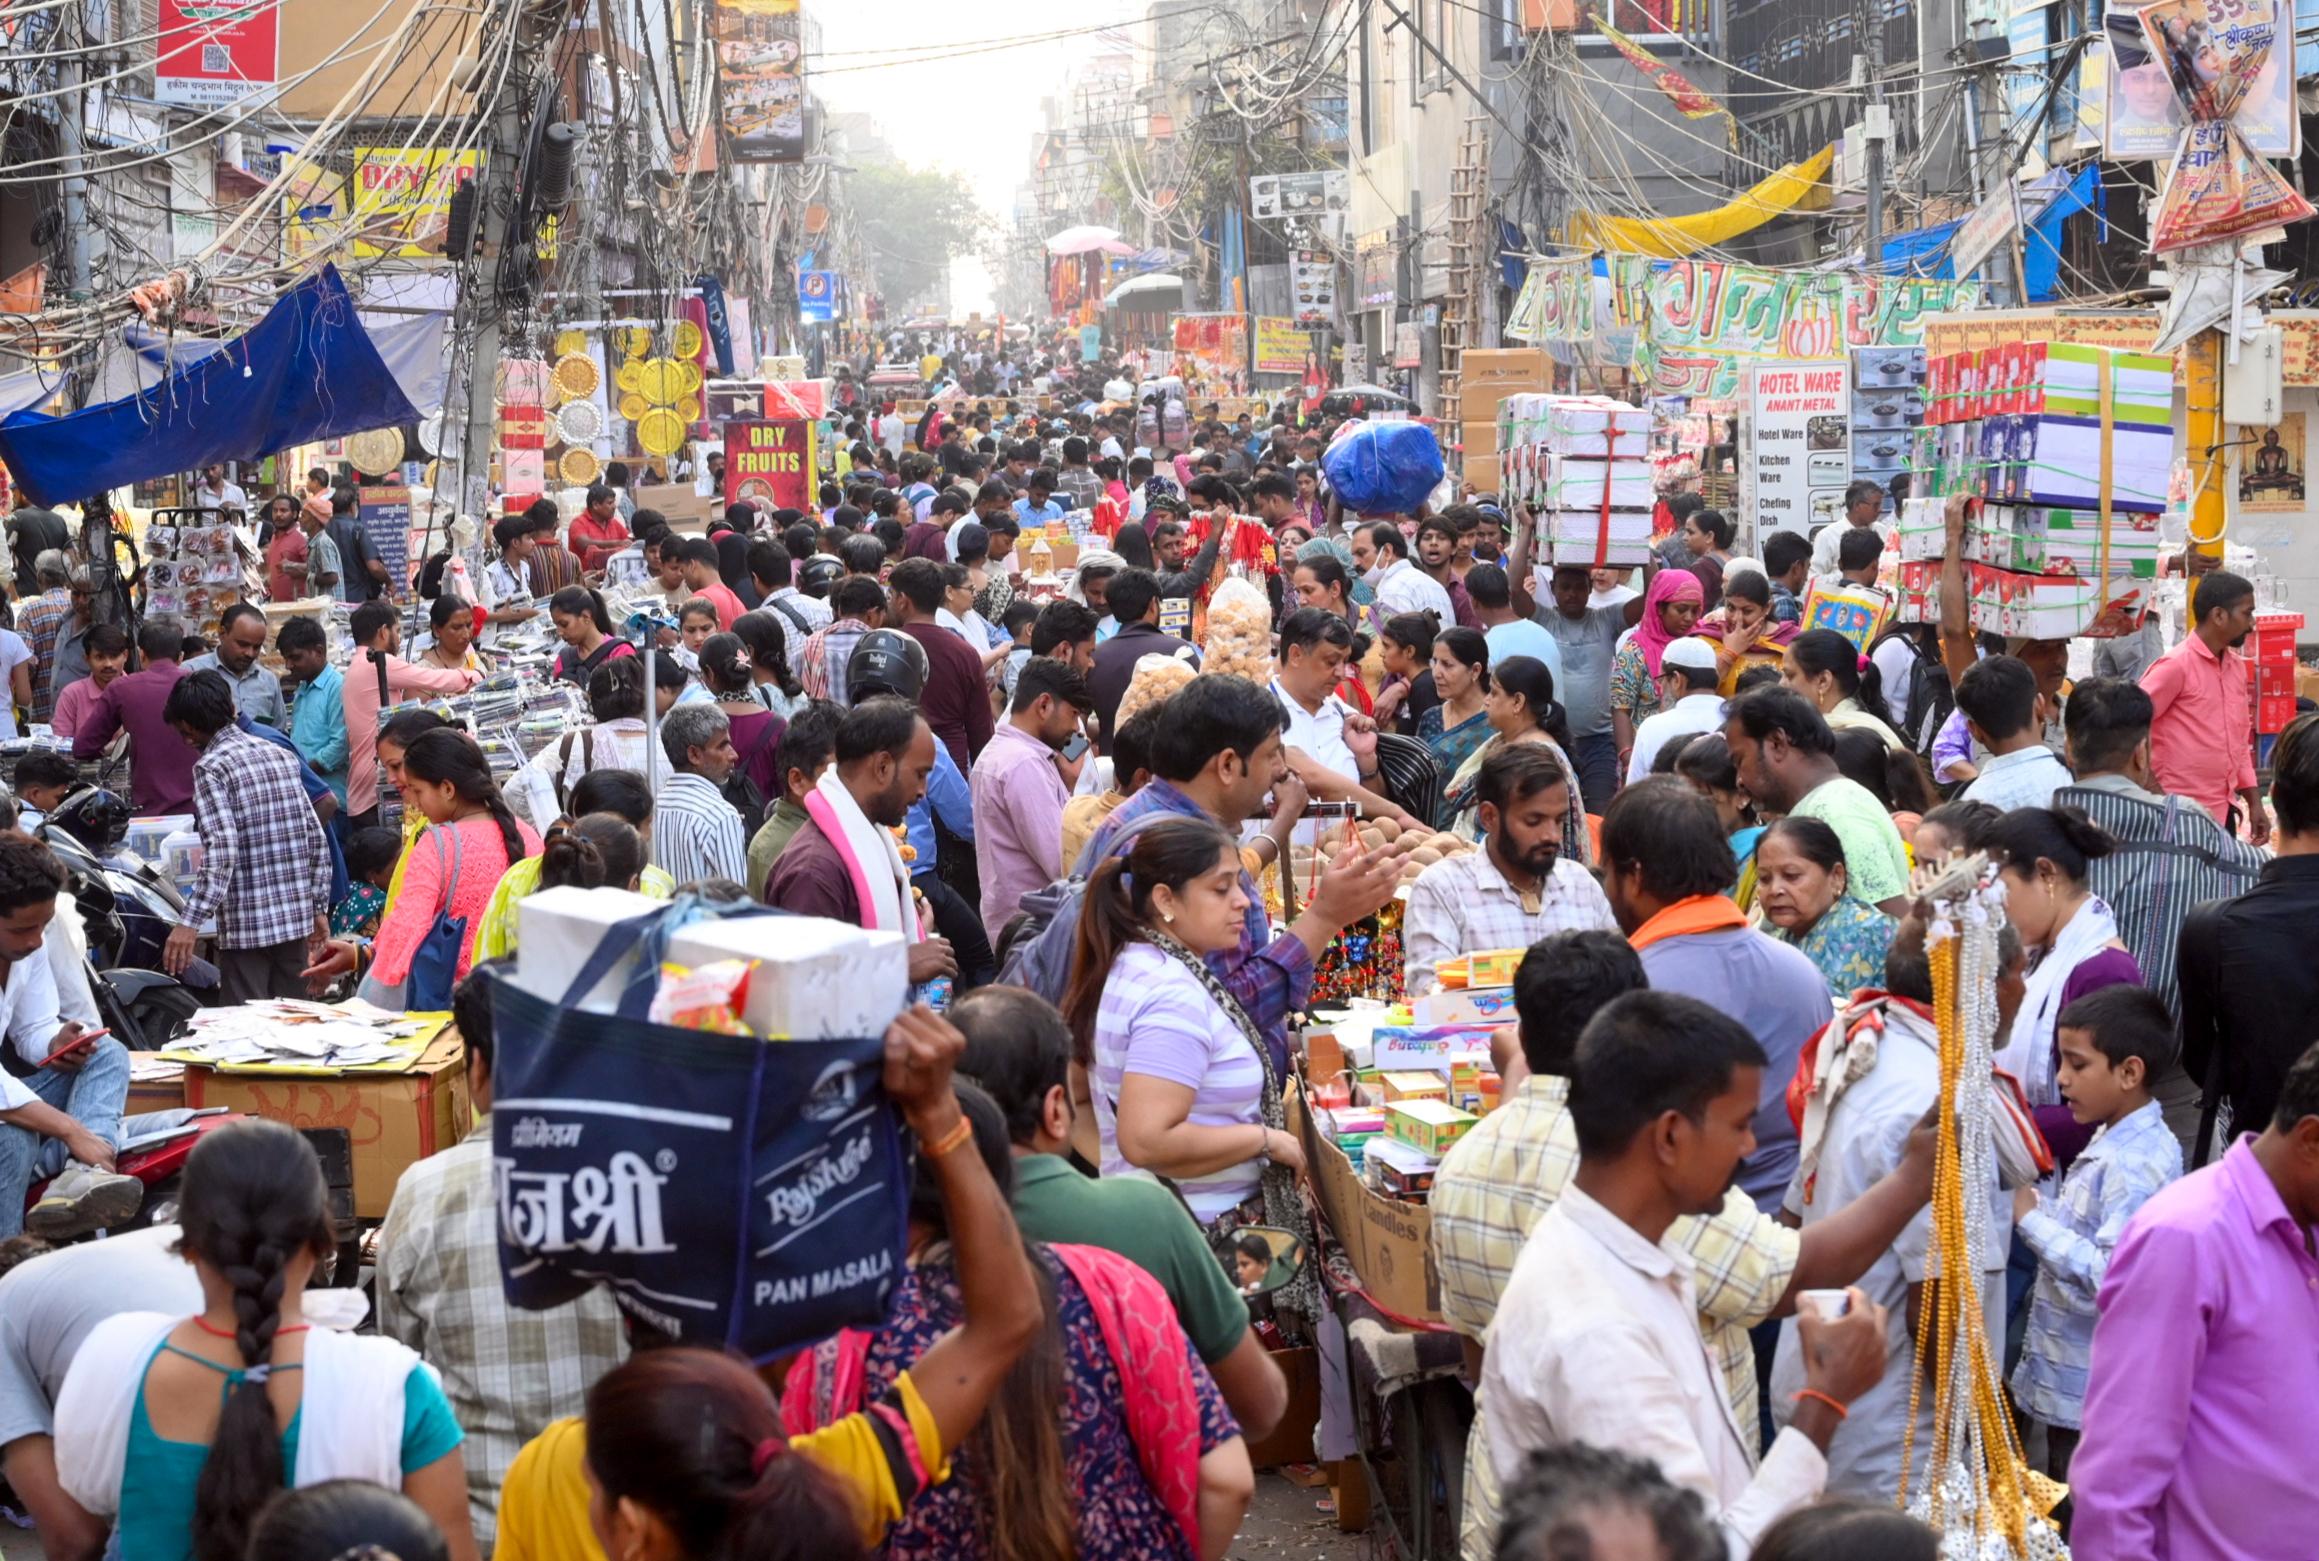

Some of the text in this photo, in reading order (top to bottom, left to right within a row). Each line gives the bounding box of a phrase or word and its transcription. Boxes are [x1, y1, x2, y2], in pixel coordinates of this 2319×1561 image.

[1759, 373, 1800, 395] HOTEL
[1804, 371, 1843, 394] WARE
[1766, 397, 1837, 412] ANANT METAL
[750, 427, 785, 448] DRY
[1758, 428, 1804, 441] Hotel Ware
[737, 452, 800, 473] FRUITS
[1759, 455, 1791, 466] Kitchen
[1759, 472, 1782, 484] Ware
[1759, 498, 1792, 511] Chefing
[1759, 515, 1779, 527] Dish
[1363, 1197, 1419, 1242] Candles
[754, 1248, 893, 1306] PAN MASALA
